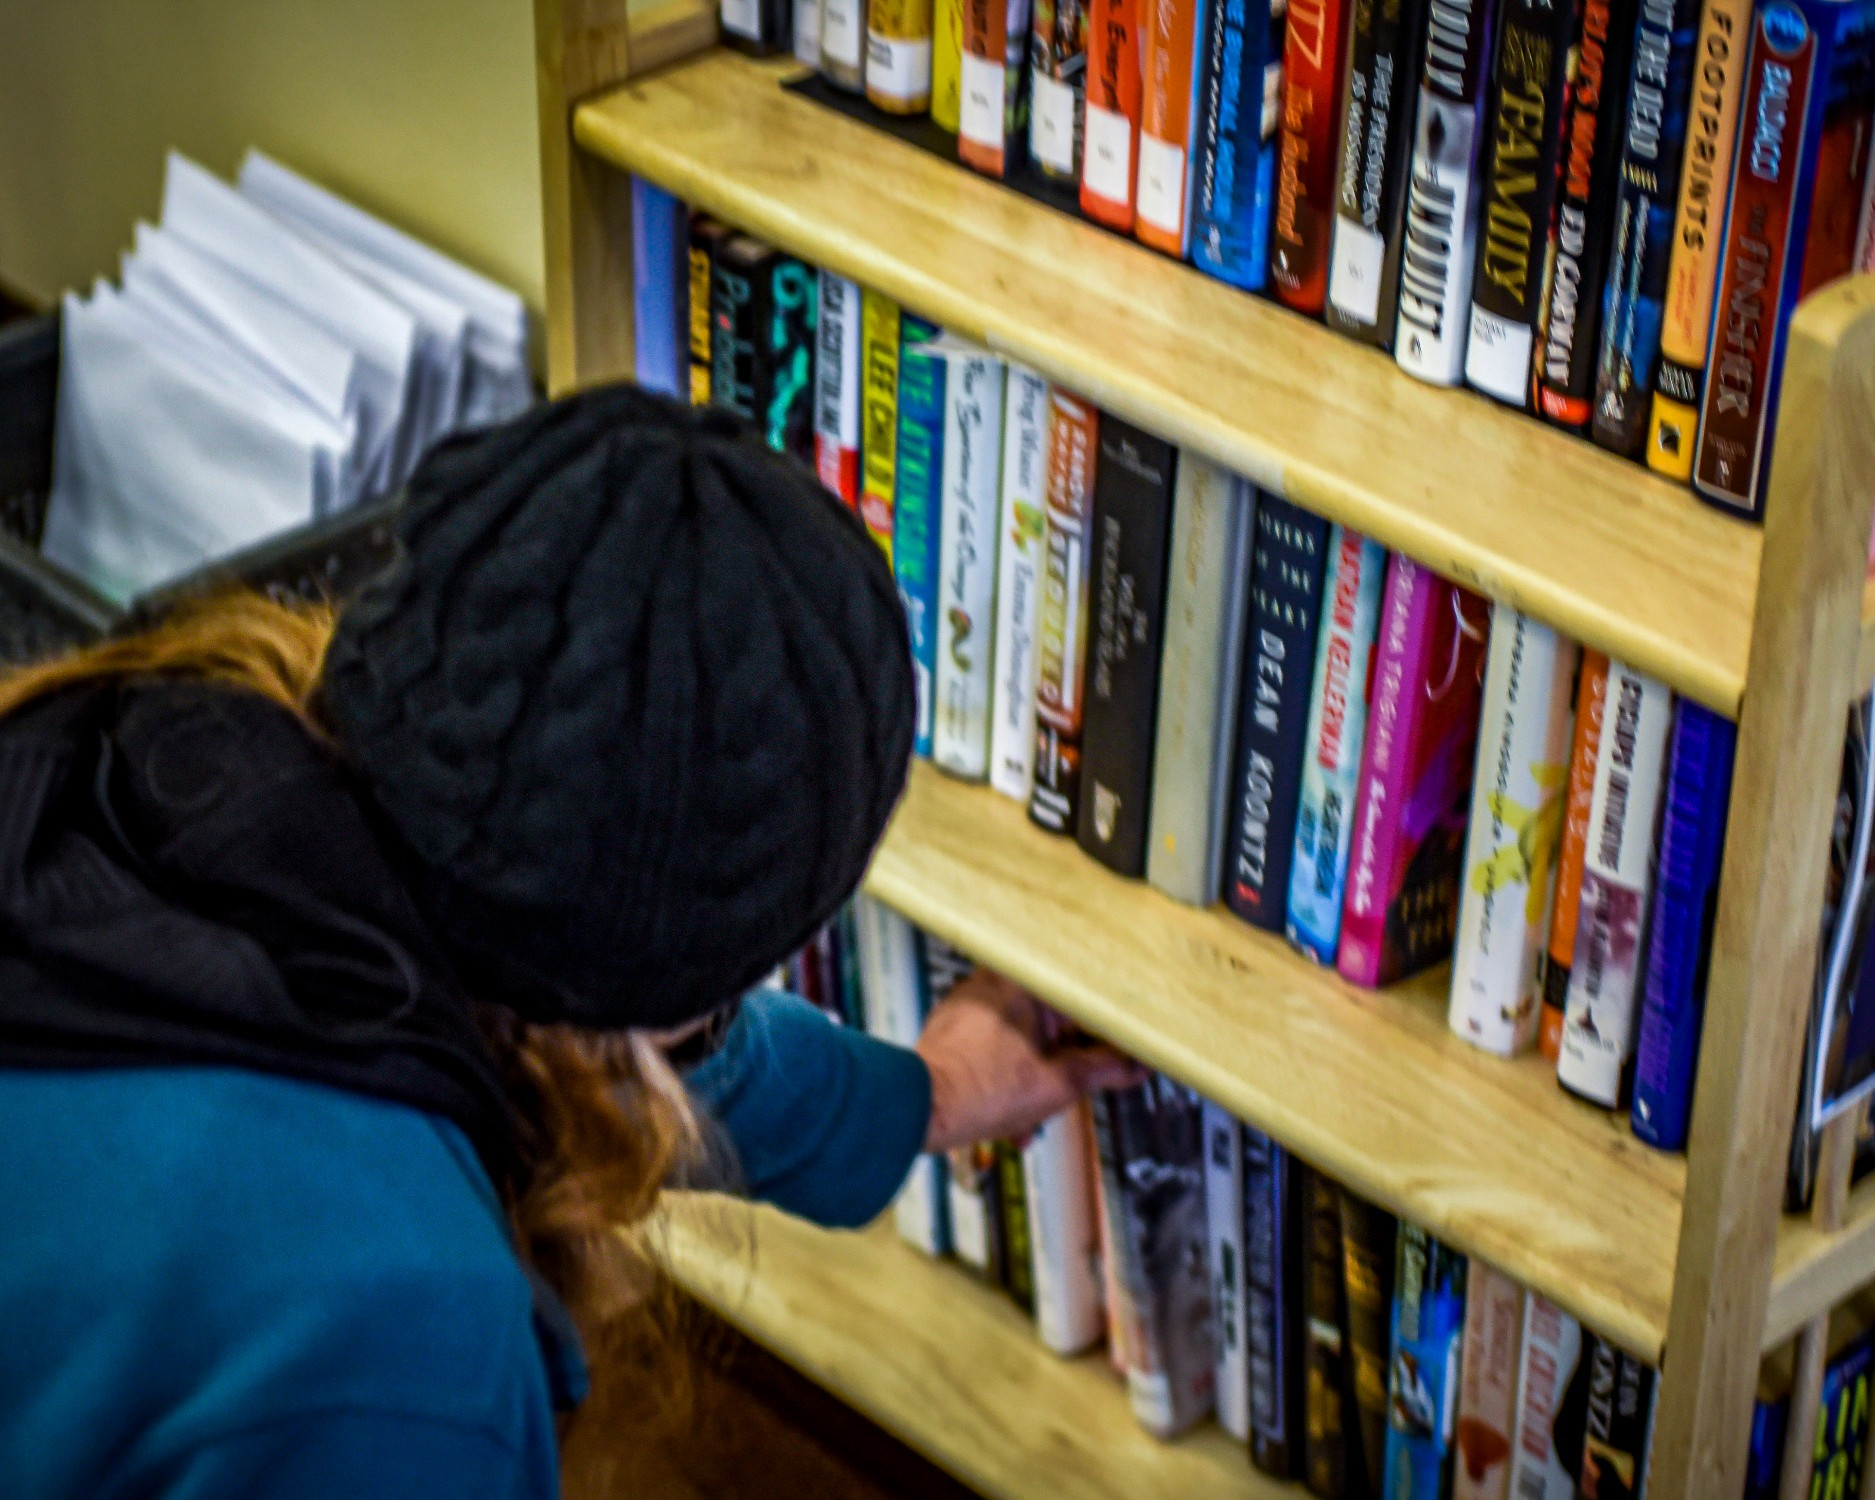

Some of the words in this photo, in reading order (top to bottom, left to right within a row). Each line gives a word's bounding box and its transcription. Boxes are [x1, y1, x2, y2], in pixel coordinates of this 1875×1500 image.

[1352, 69, 1366, 101] IS
[1372, 53, 1393, 111] THE
[1637, 27, 1671, 88] THE
[1342, 101, 1364, 209] MISSING
[1629, 80, 1664, 160] DEAD
[1683, 8, 1733, 252] FOOTPRINTS
[1750, 59, 1793, 184] BALDACCI
[1485, 80, 1544, 305] FAMILY
[1560, 202, 1585, 256] ED
[868, 340, 895, 399] LEE
[1546, 253, 1581, 387] GORMAN
[1716, 233, 1772, 419] FINISHER
[865, 404, 895, 486] CHILD
[1255, 628, 1286, 733] DEAN
[1317, 630, 1351, 773] KELLERMAN
[1238, 749, 1273, 889] KOONTZ
